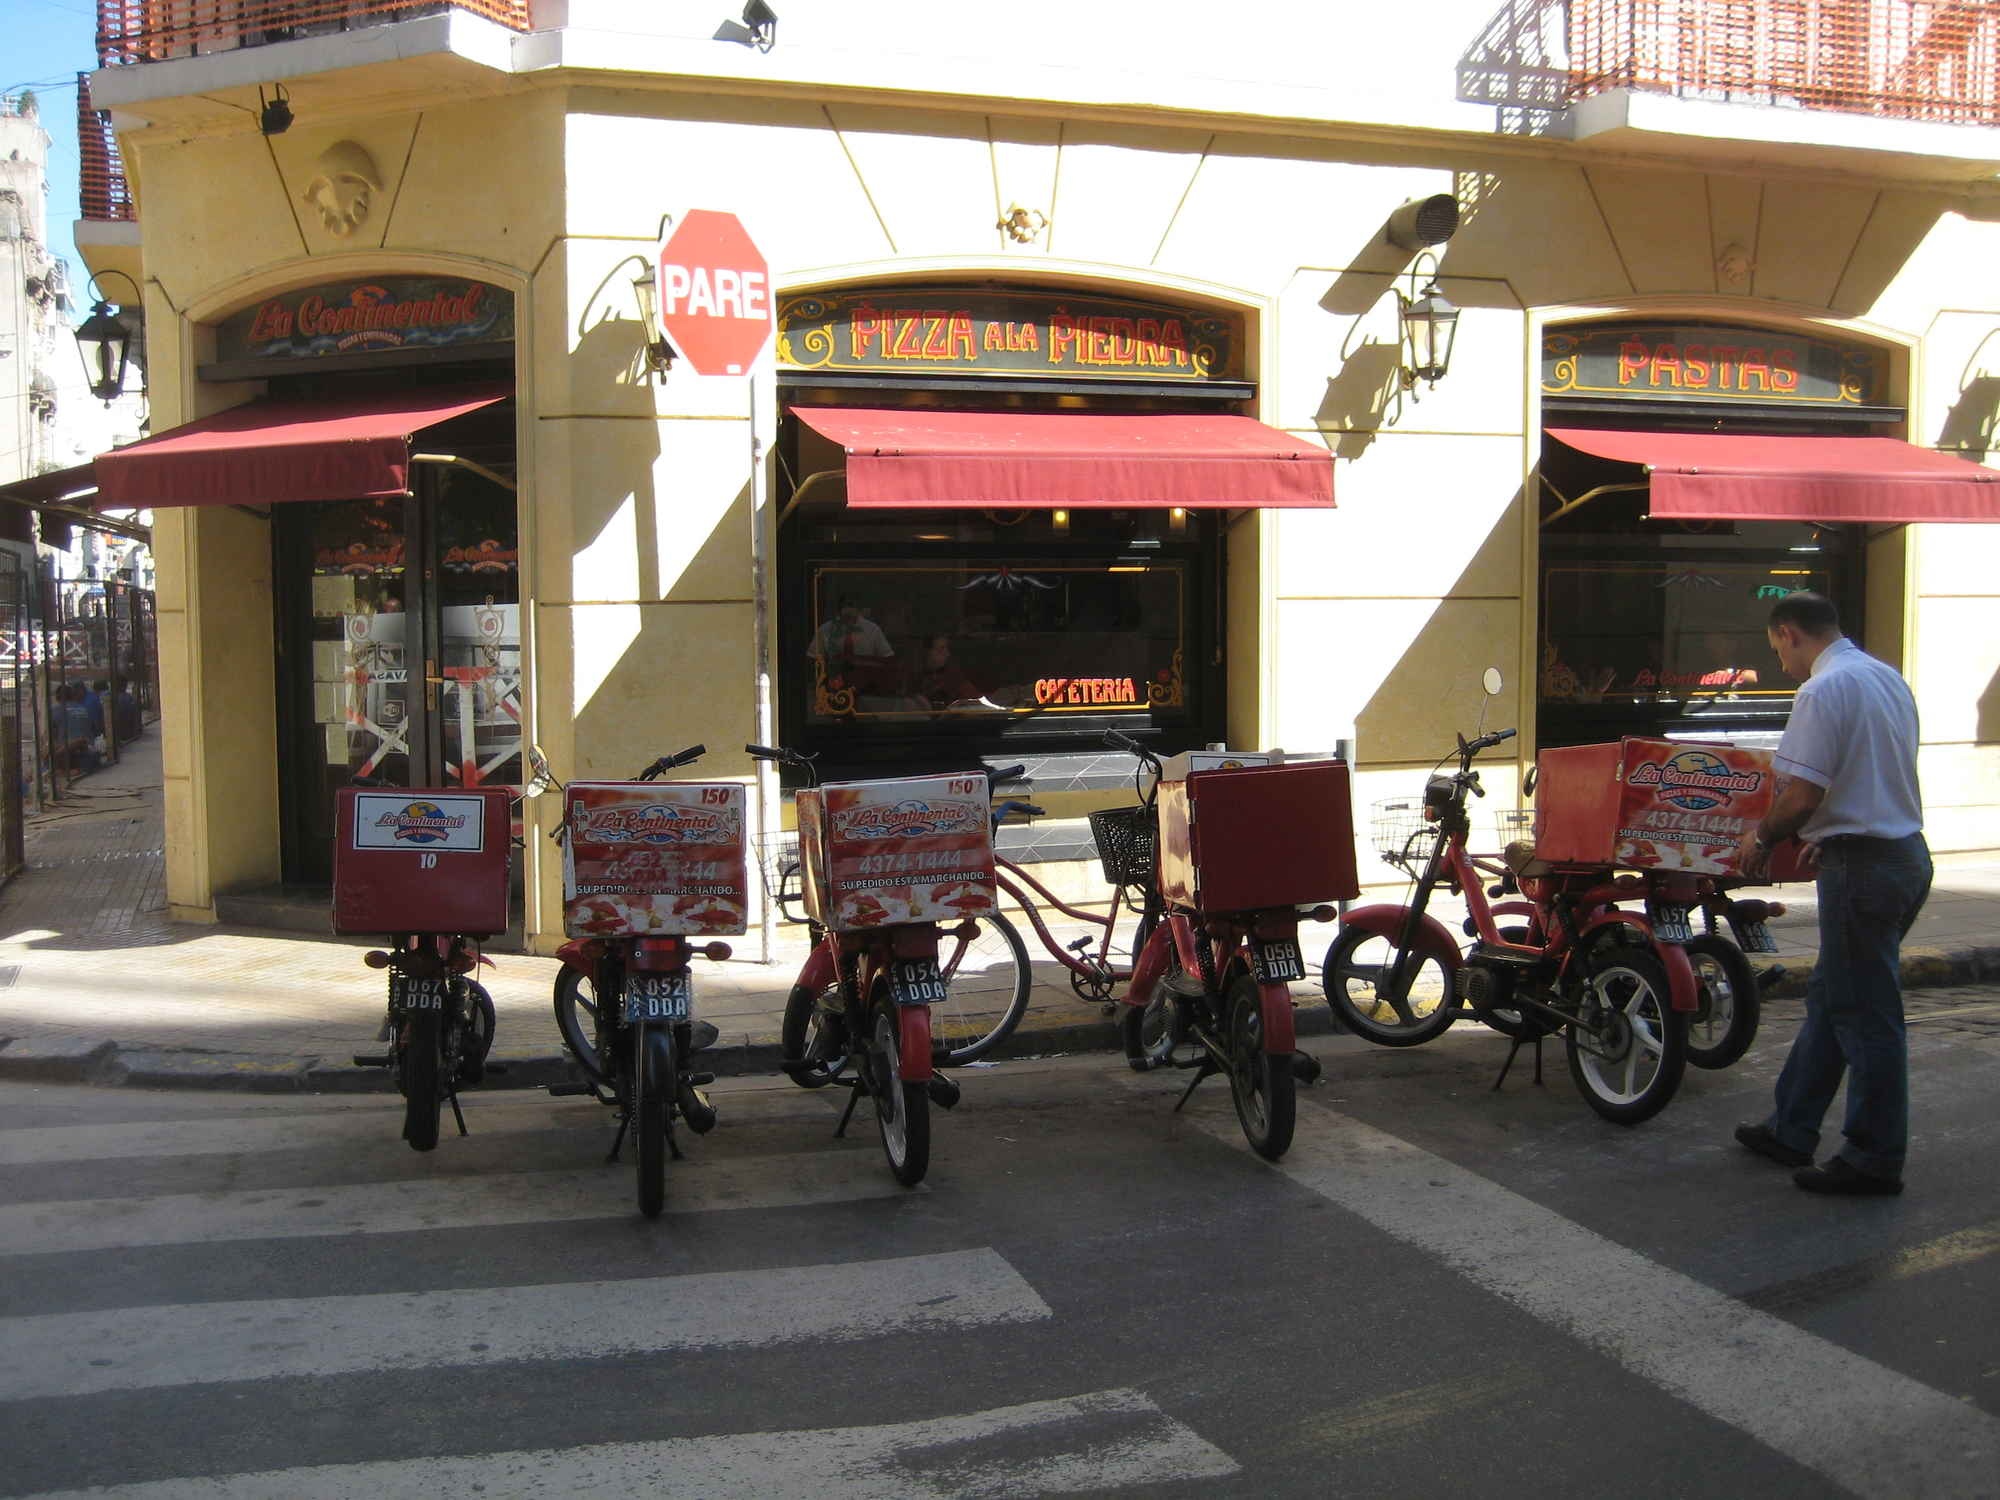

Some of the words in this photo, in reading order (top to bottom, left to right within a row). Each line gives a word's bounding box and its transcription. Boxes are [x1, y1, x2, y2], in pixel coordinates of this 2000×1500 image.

[664, 264, 768, 320] PARE
[252, 301, 293, 340] La
[298, 284, 484, 336] Continental
[850, 302, 977, 361] PIZZA
[1048, 306, 1188, 367] PIEDRA
[1618, 334, 1799, 392] PASTAS
[1035, 678, 1135, 704] CAFETERIA
[1630, 764, 1661, 784] La
[1663, 766, 1758, 791] Continental
[376, 812, 397, 827] La
[398, 813, 465, 828] Continental
[597, 812, 623, 830] La
[625, 815, 716, 830] Continental
[854, 810, 877, 825] La
[881, 804, 963, 823] Continental
[1647, 810, 1744, 834] 4374-1444
[1632, 831, 1666, 841] PEDIDO
[421, 853, 437, 868] 10
[841, 880, 853, 889] SU
[856, 879, 894, 889] PEDIDO
[1661, 908, 1686, 922] 057
[1665, 924, 1693, 939] DDA
[1264, 944, 1295, 961] 058
[905, 961, 939, 982] 054
[1267, 960, 1299, 977] DDA
[647, 978, 684, 996] 052
[908, 981, 944, 1000] DDA
[407, 993, 442, 1009] DDA
[648, 997, 686, 1016] DDA
